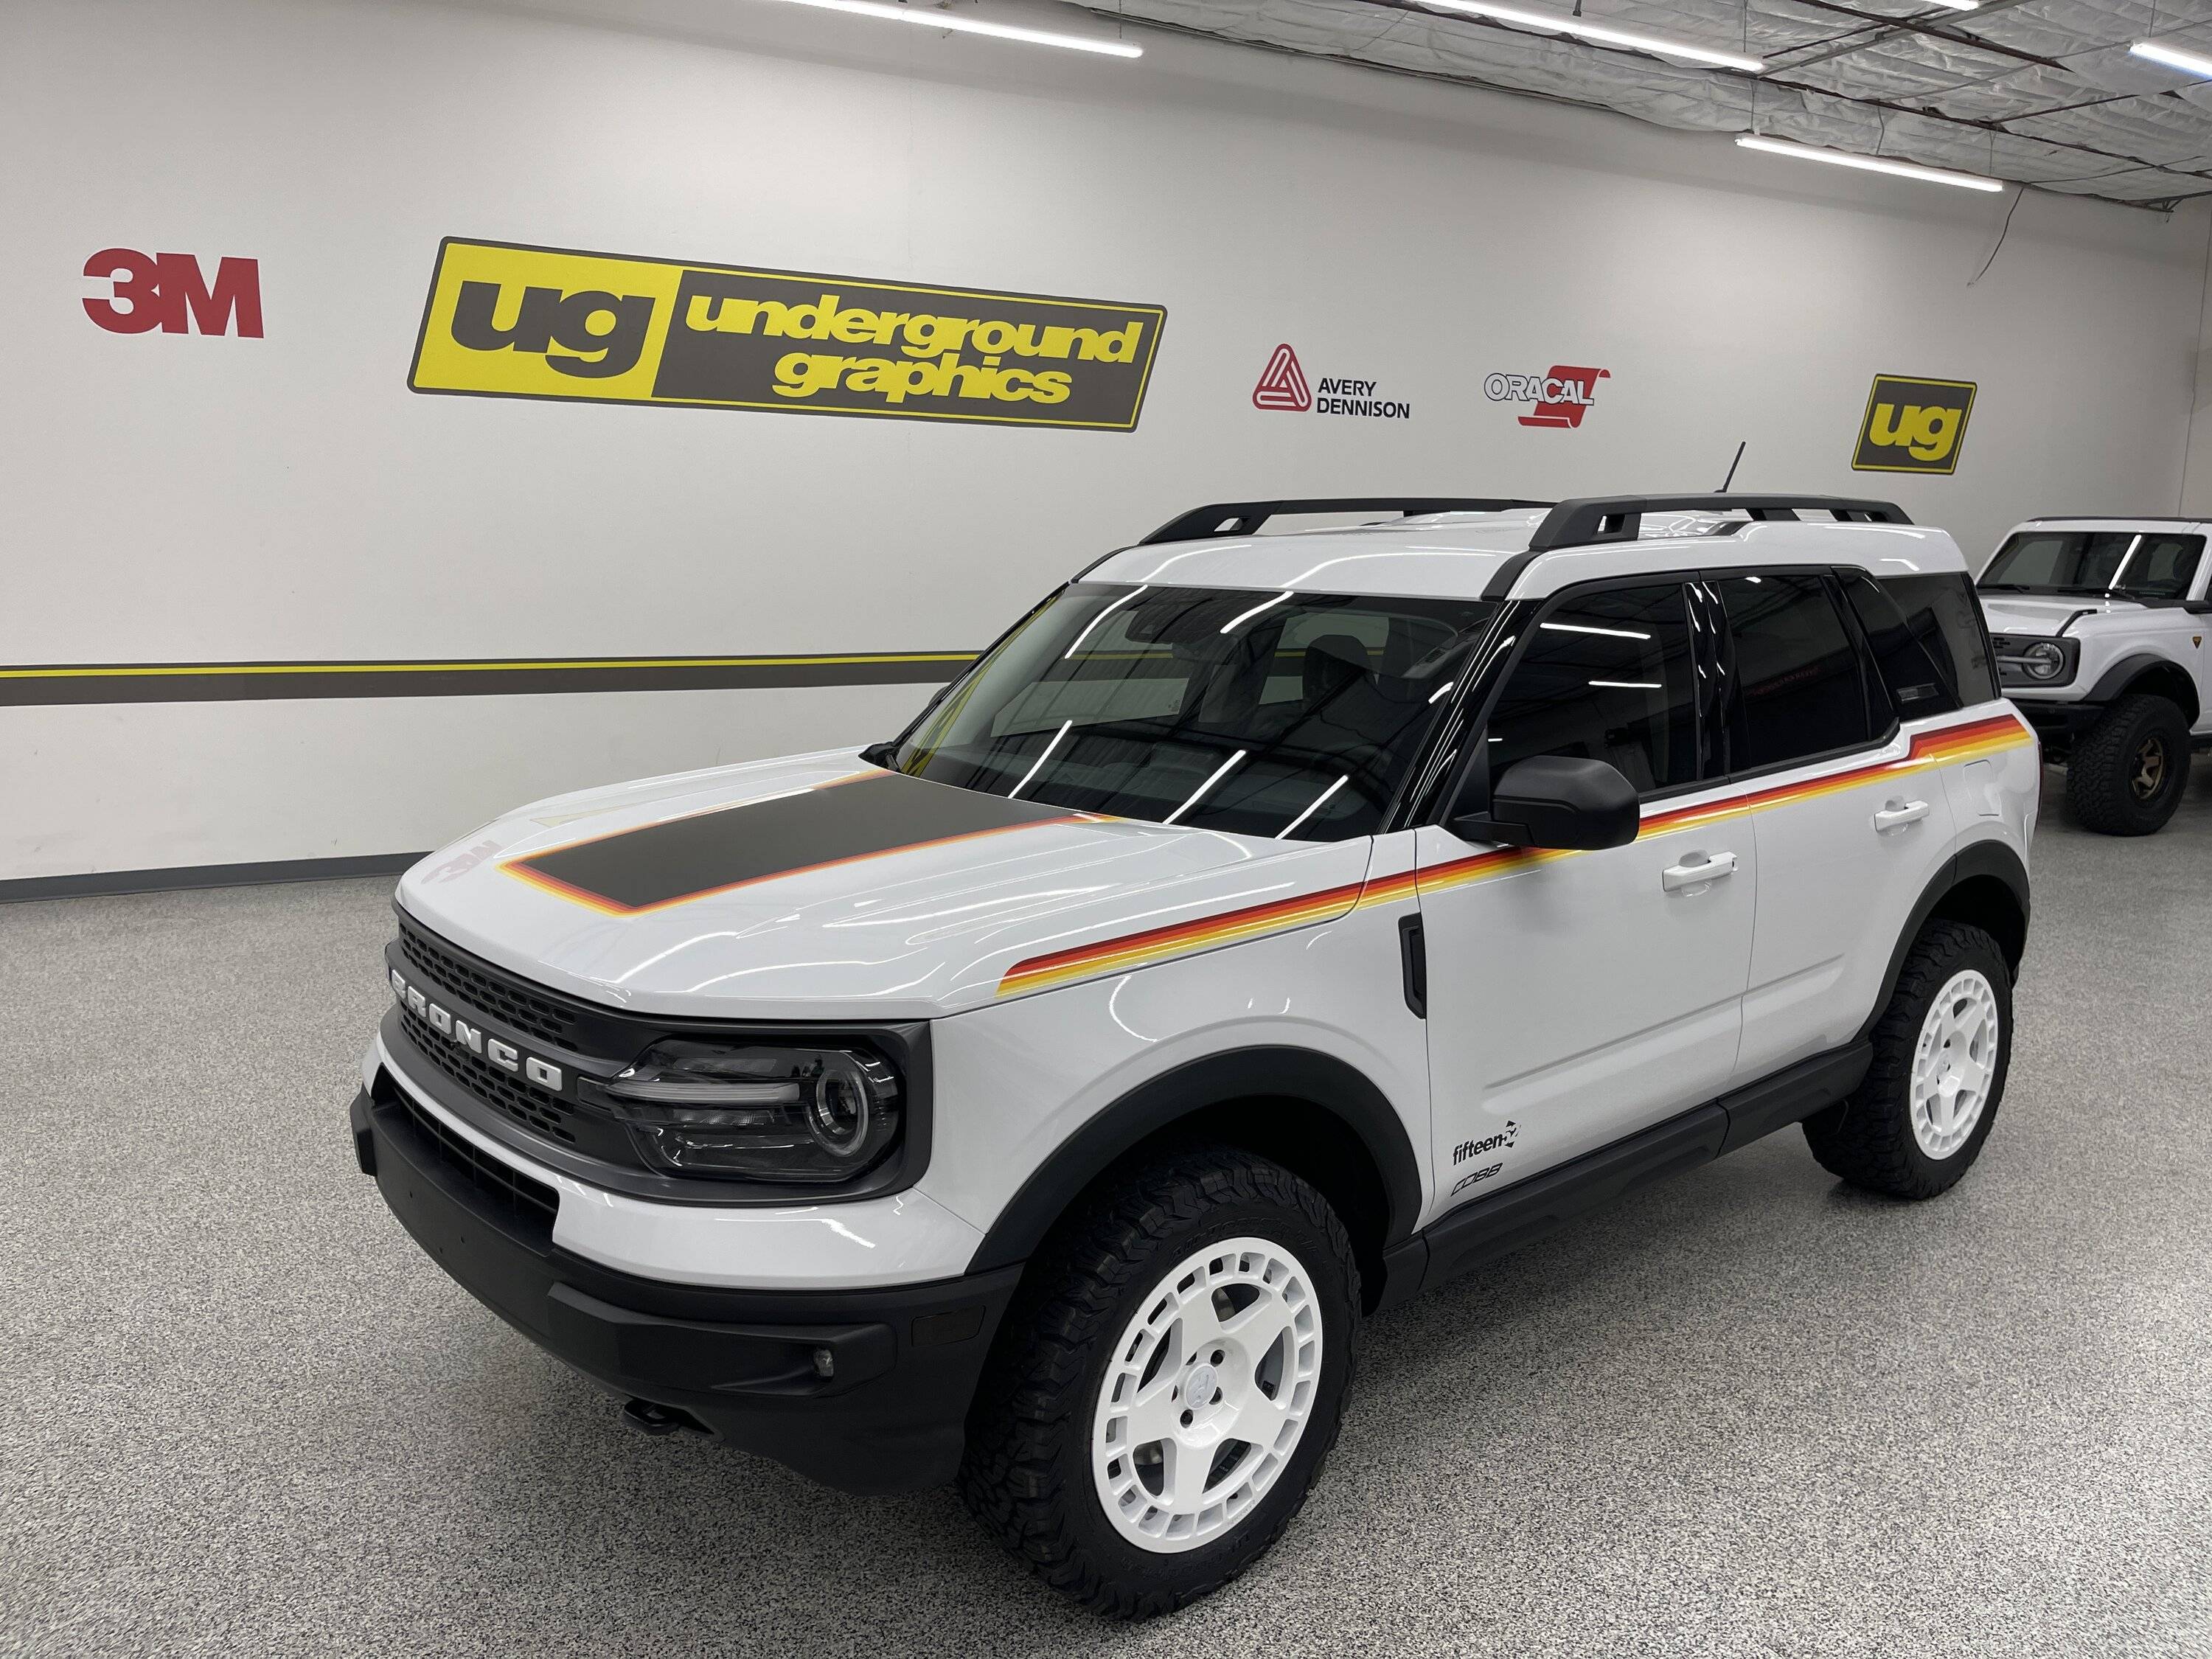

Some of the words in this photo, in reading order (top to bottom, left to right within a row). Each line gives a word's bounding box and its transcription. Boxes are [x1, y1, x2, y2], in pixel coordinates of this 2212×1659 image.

[82, 248, 264, 338] 3M
[451, 280, 656, 379] ug
[686, 294, 1144, 364] underground
[772, 352, 1073, 403] graphics
[1317, 377, 1377, 397] AVERY
[1484, 372, 1595, 406] ORACAL
[1316, 397, 1410, 420] DENNISON
[1869, 403, 1963, 462] ug
[391, 968, 563, 1092] BRONCO
